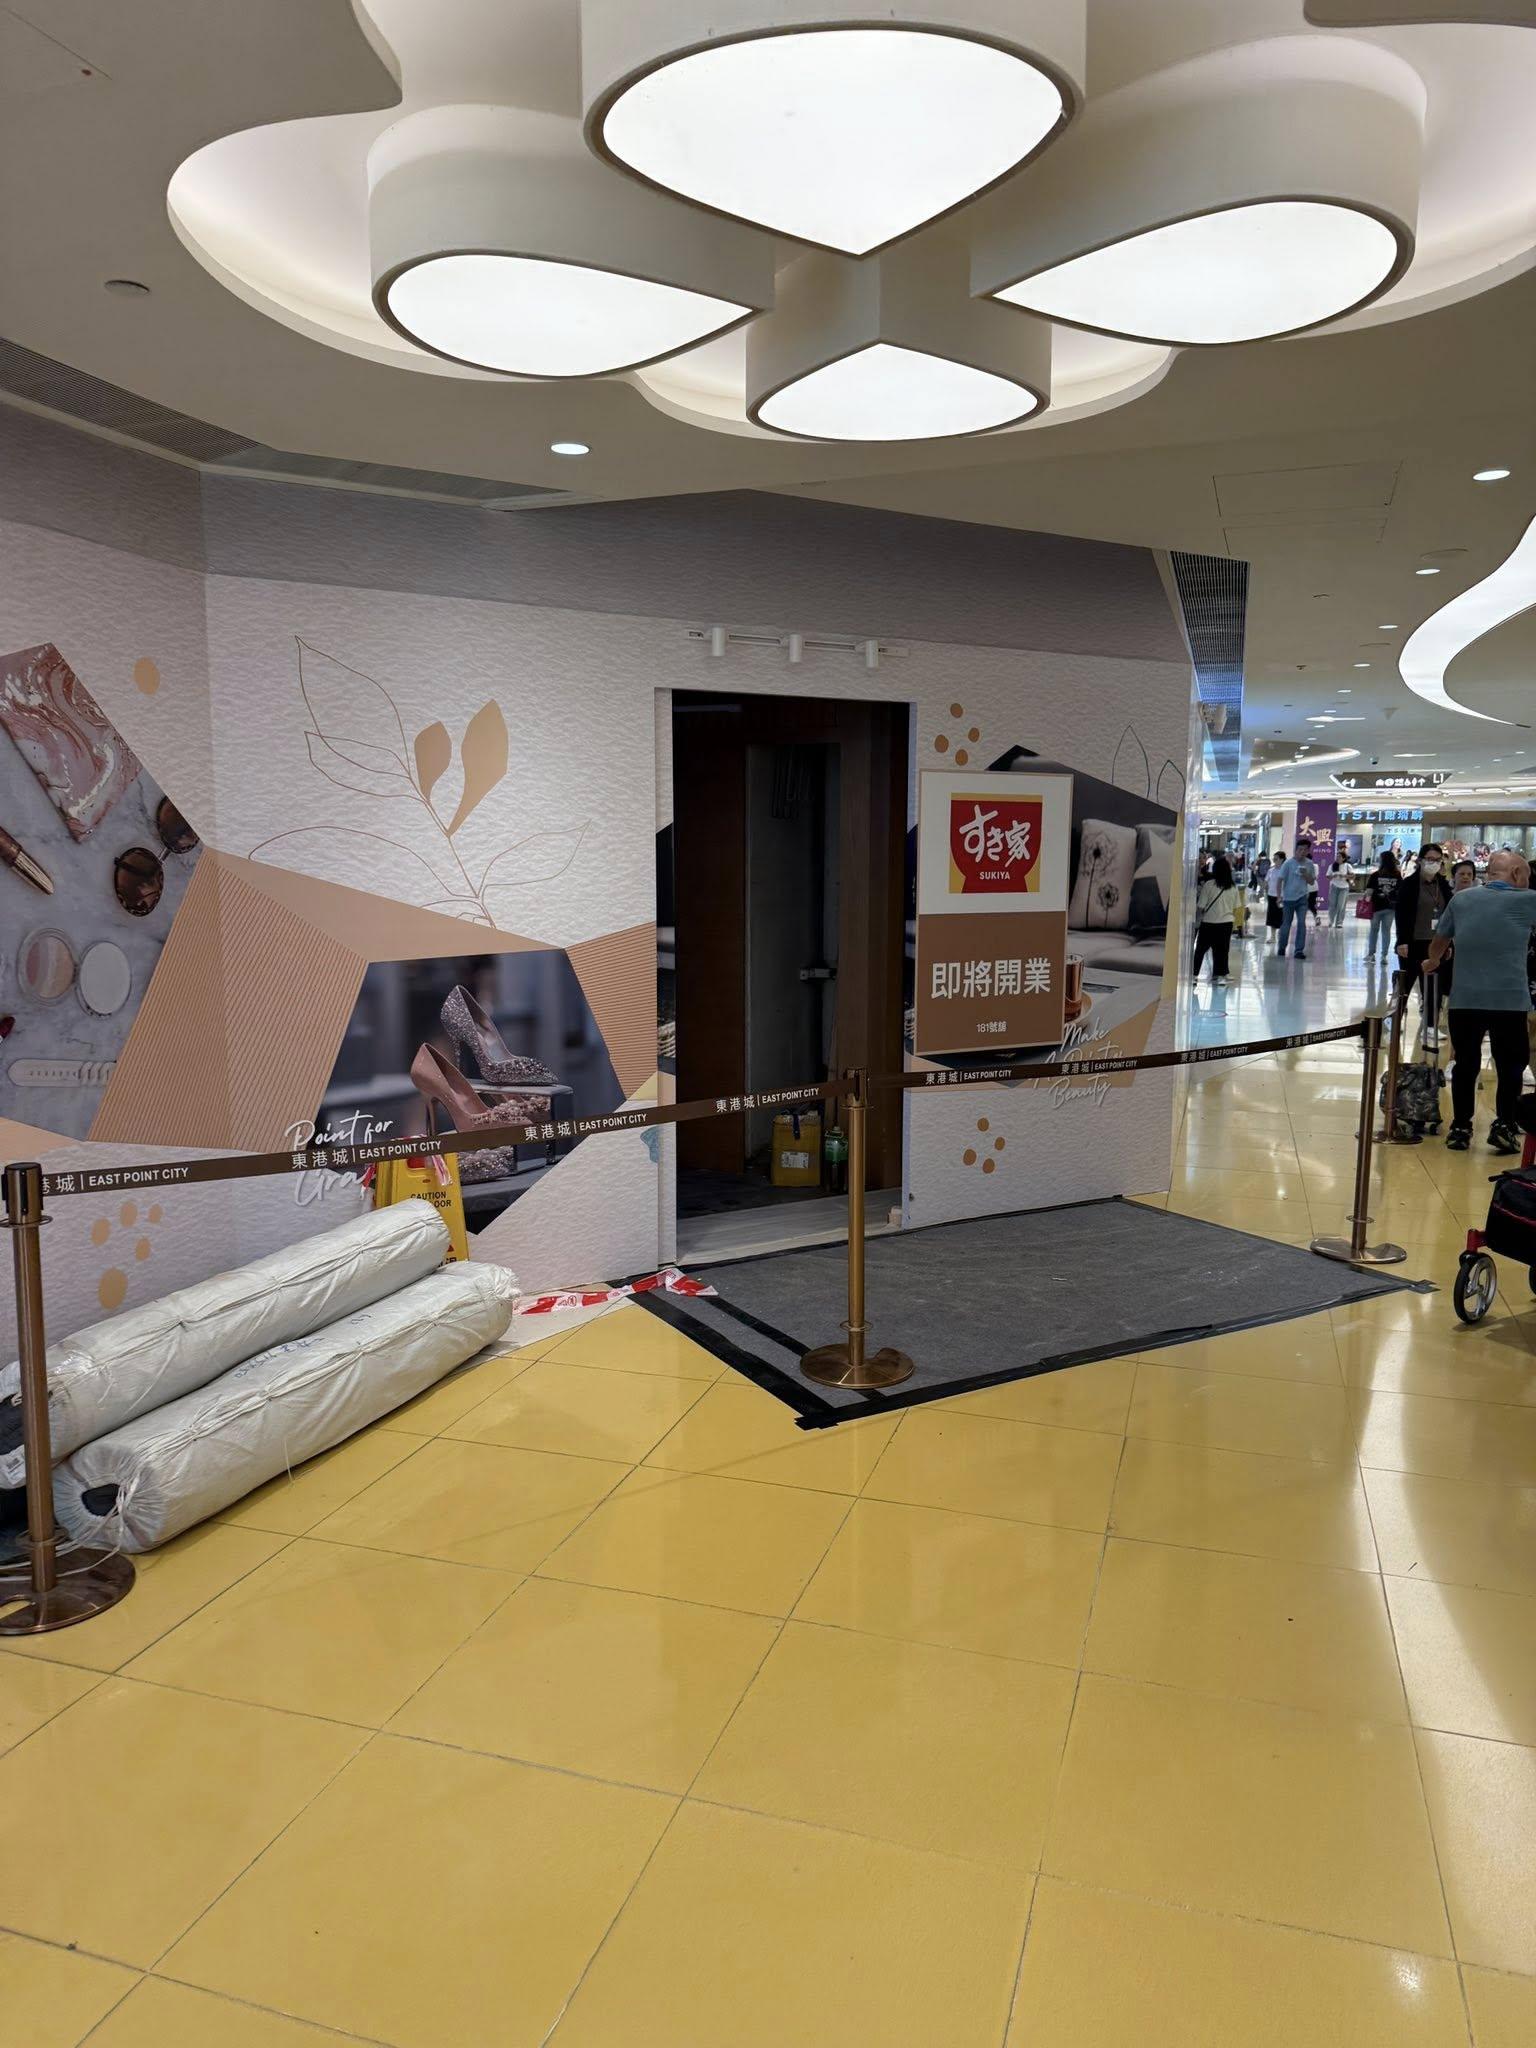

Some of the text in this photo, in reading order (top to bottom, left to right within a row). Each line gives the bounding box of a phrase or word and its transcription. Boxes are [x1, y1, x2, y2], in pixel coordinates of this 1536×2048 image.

[1338, 810, 1376, 820] TSL
[959, 804, 1032, 868] すき家
[979, 871, 1011, 881] SUKIYA
[931, 958, 1052, 999] 即將開業
[1060, 1016, 1109, 1052] Make
[964, 1069, 1012, 1080] EAST POINT CITY
[1094, 1060, 1138, 1071] EAST POINT CITY
[926, 1071, 958, 1085] 東港城
[762, 1088, 820, 1104] EAST POINT CITY
[1048, 1073, 1111, 1109] Beauty
[716, 1095, 755, 1113] 東港城
[285, 1110, 394, 1150] Point for
[524, 1121, 571, 1141] 東港城
[579, 1113, 648, 1131] EAST POINT CITY
[291, 1148, 349, 1169] 東港城
[359, 1140, 442, 1159] EAST POINT CITY
[89, 1167, 189, 1187] EAST POINT CITY
[410, 1191, 447, 1200] CAUTION
